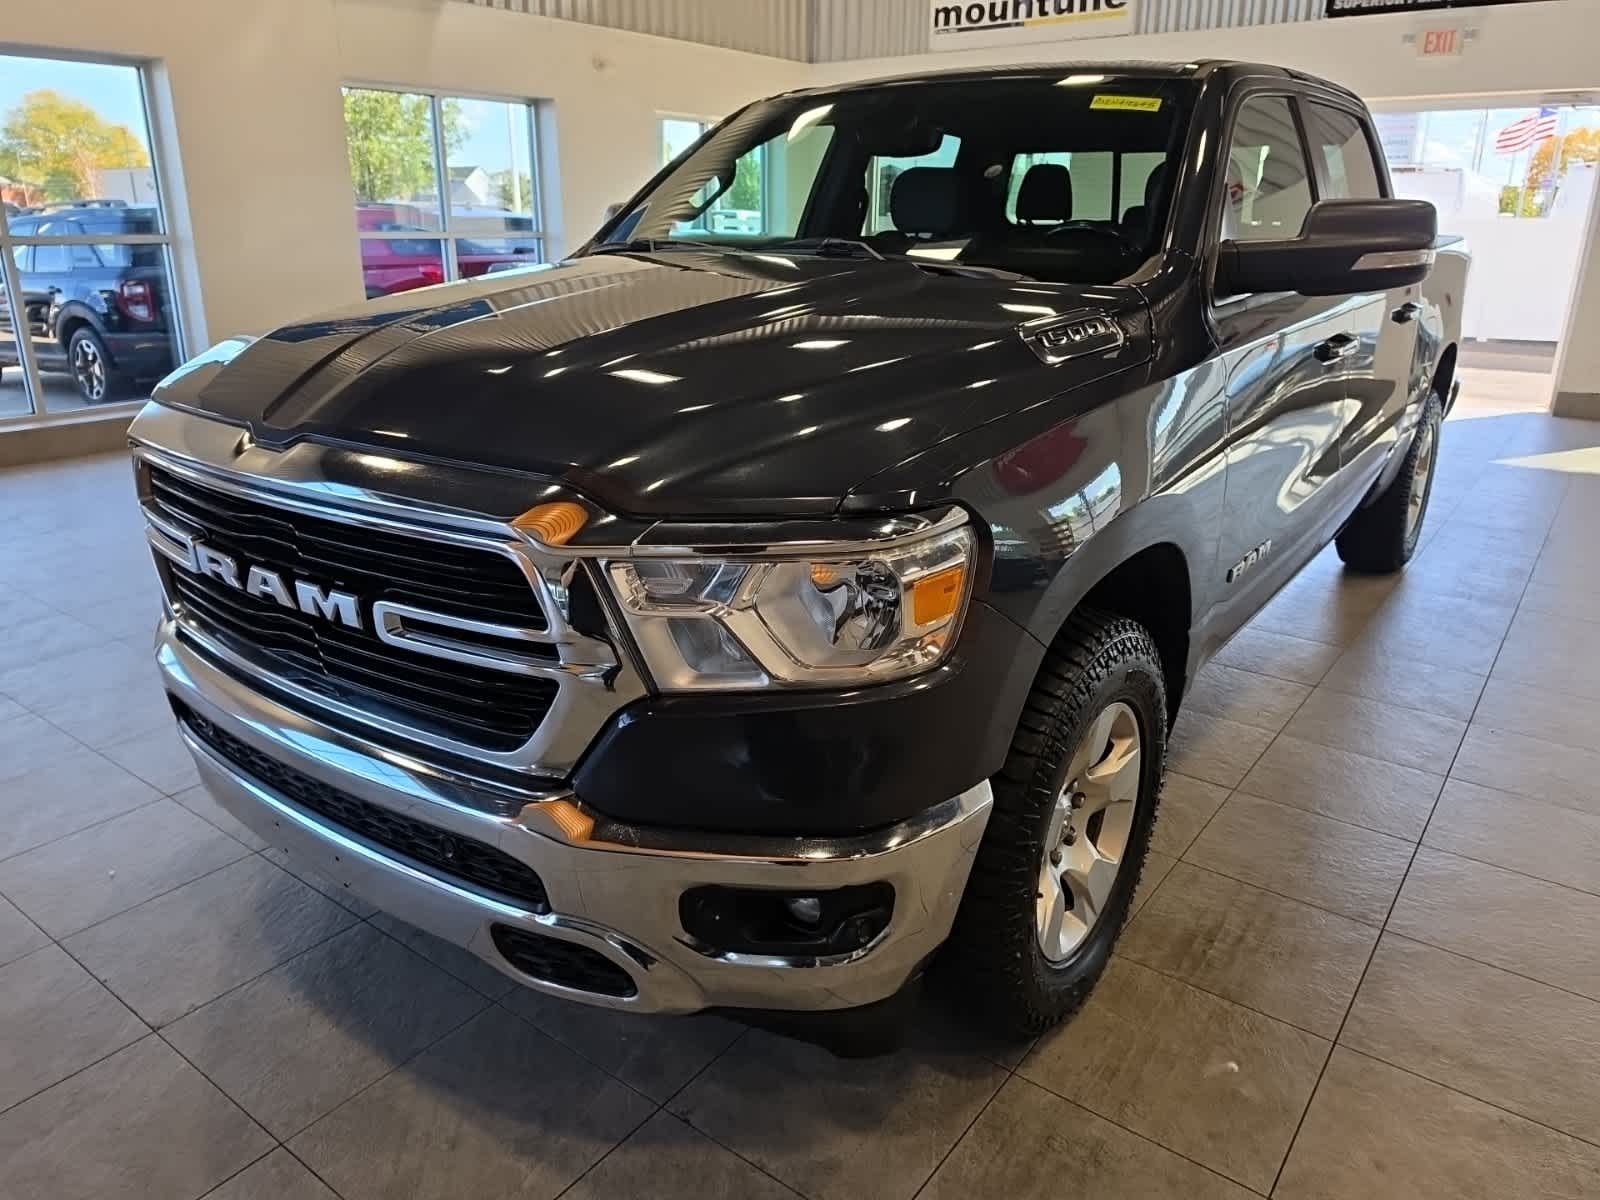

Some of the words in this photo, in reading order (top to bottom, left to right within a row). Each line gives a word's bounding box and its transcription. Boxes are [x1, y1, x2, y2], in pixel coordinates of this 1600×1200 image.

[1423, 29, 1455, 54] EXIT
[1040, 320, 1107, 349] 1500
[1226, 538, 1272, 585] RAM
[195, 543, 364, 631] RAM
